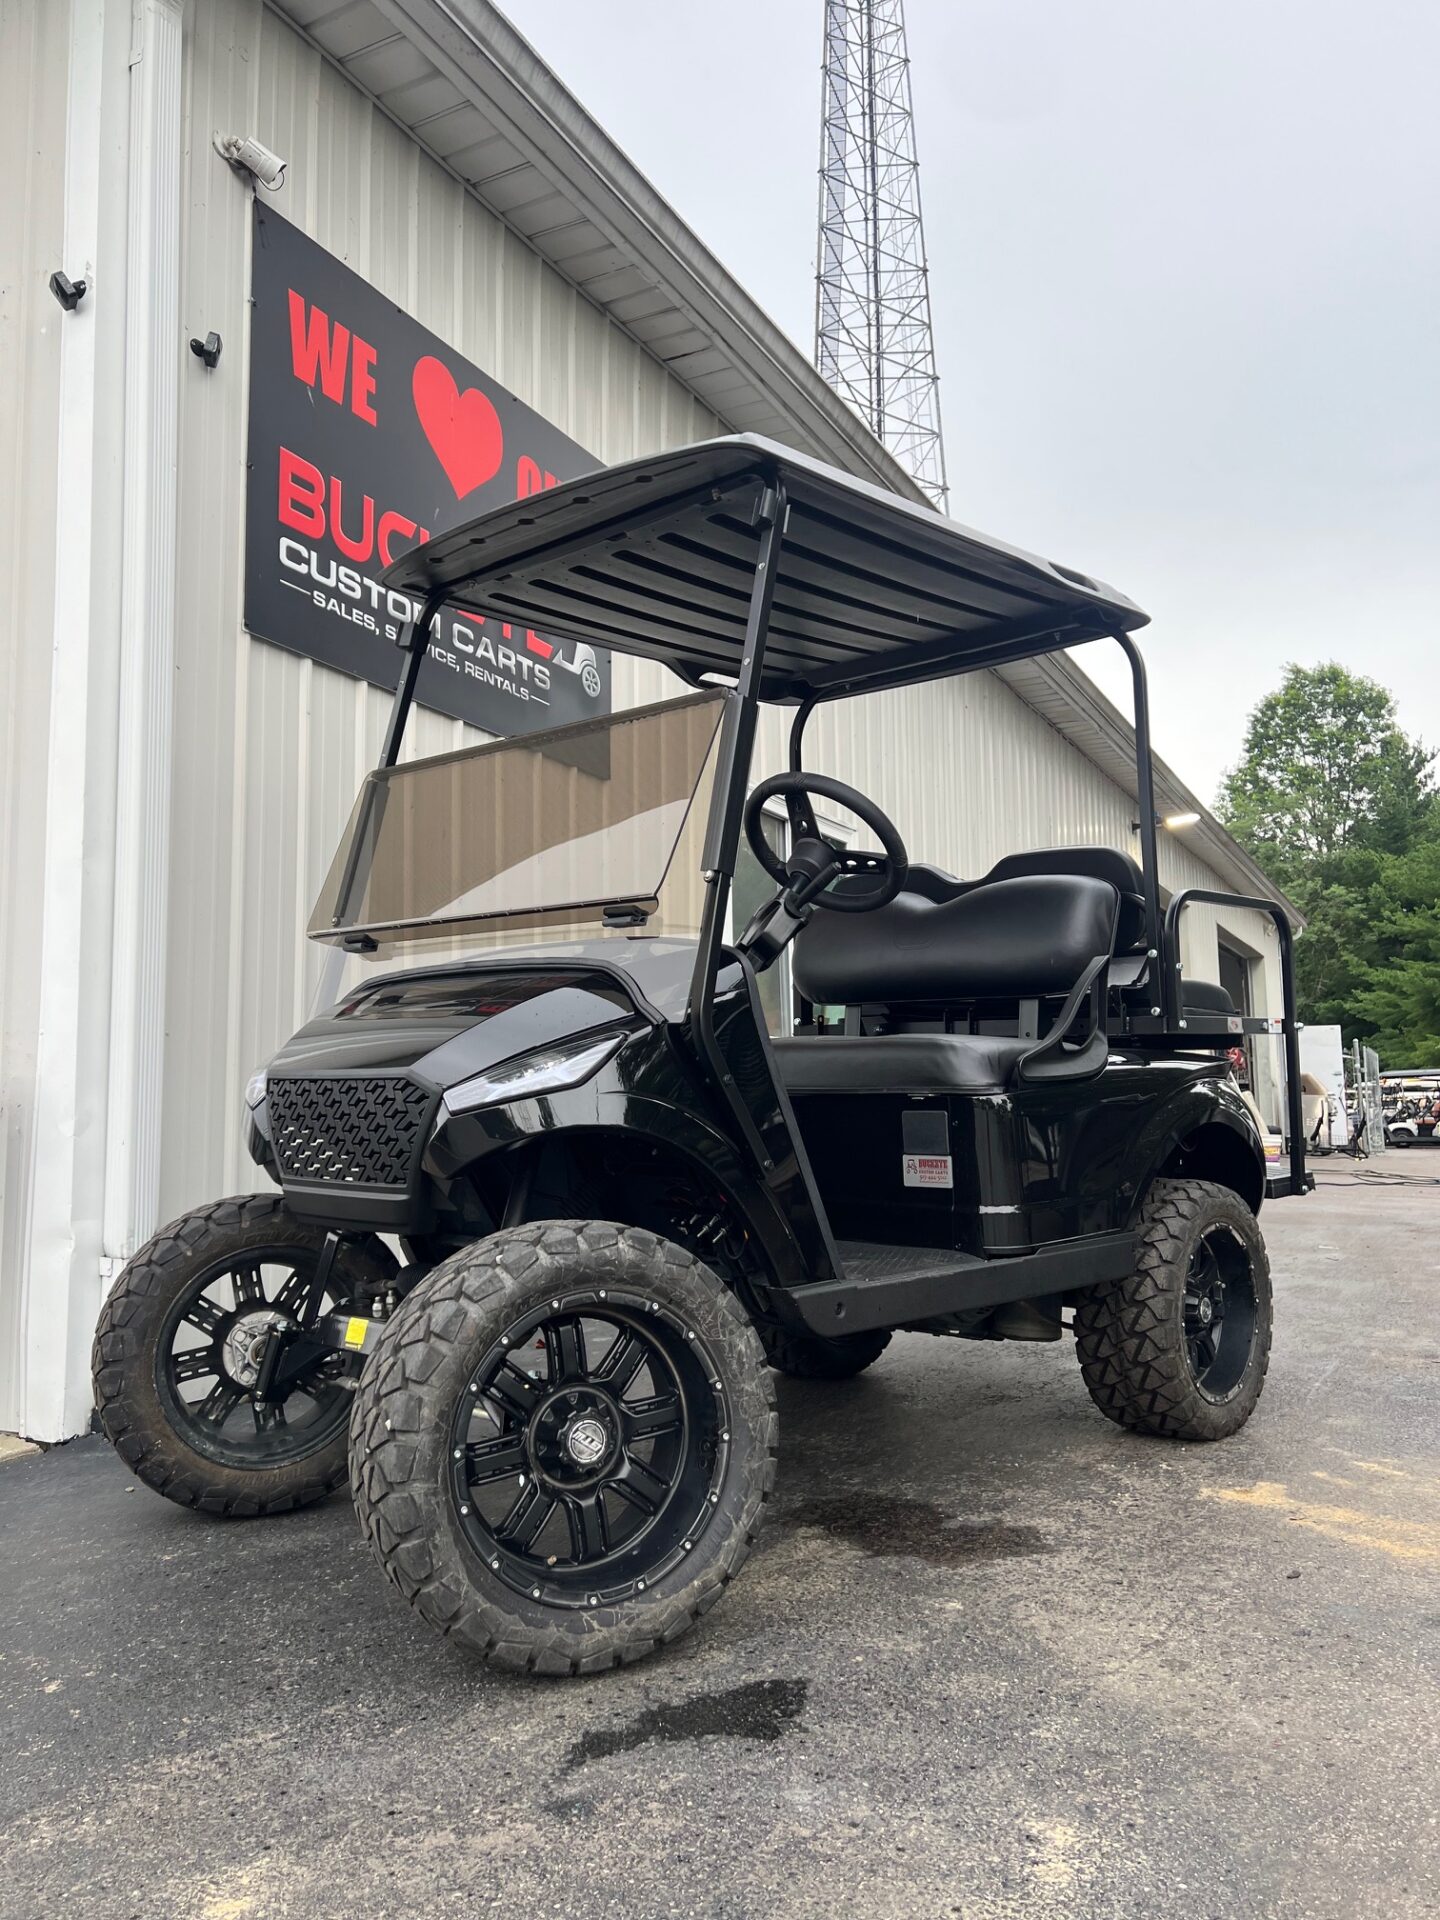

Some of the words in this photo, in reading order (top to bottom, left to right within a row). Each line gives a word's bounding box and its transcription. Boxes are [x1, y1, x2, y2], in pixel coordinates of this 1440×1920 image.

[288, 287, 377, 428] WE
[313, 590, 380, 636] SALES,
[385, 623, 460, 672] SICE,
[464, 661, 530, 701] RENTALS
[452, 622, 551, 690] CARTS
